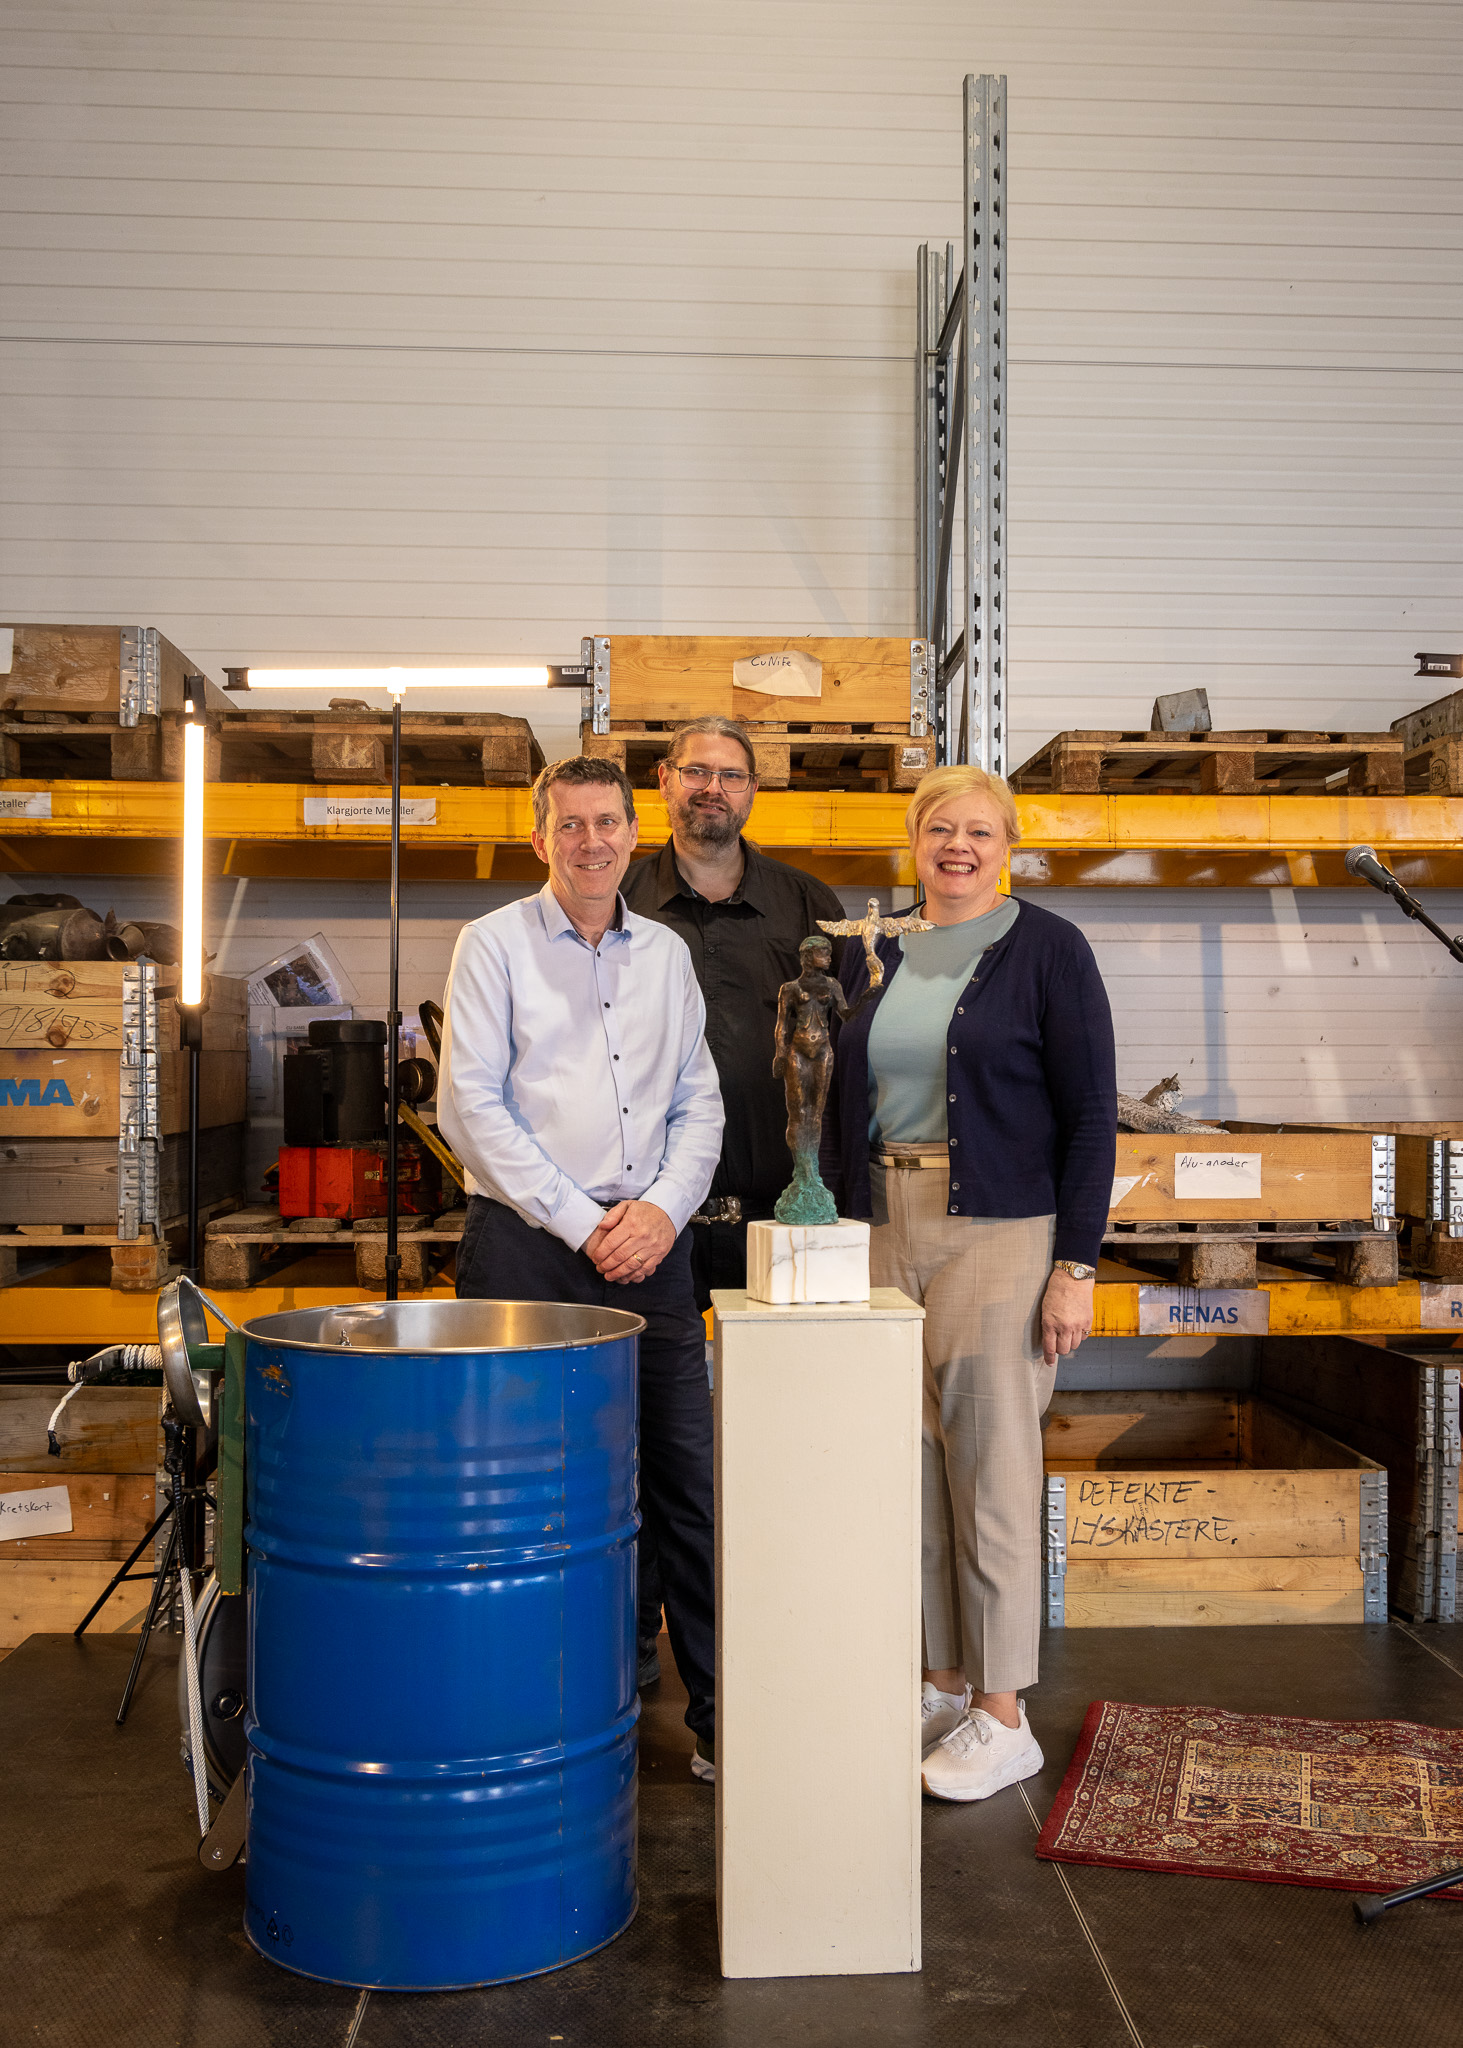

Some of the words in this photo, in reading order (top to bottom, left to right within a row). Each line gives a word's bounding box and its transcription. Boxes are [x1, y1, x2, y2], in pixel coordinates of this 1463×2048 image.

[326, 806, 373, 817] Klargjorte
[375, 806, 415, 815] Meller
[1180, 1155, 1249, 1169] Alu-anoder
[1169, 1305, 1239, 1324] RENAS
